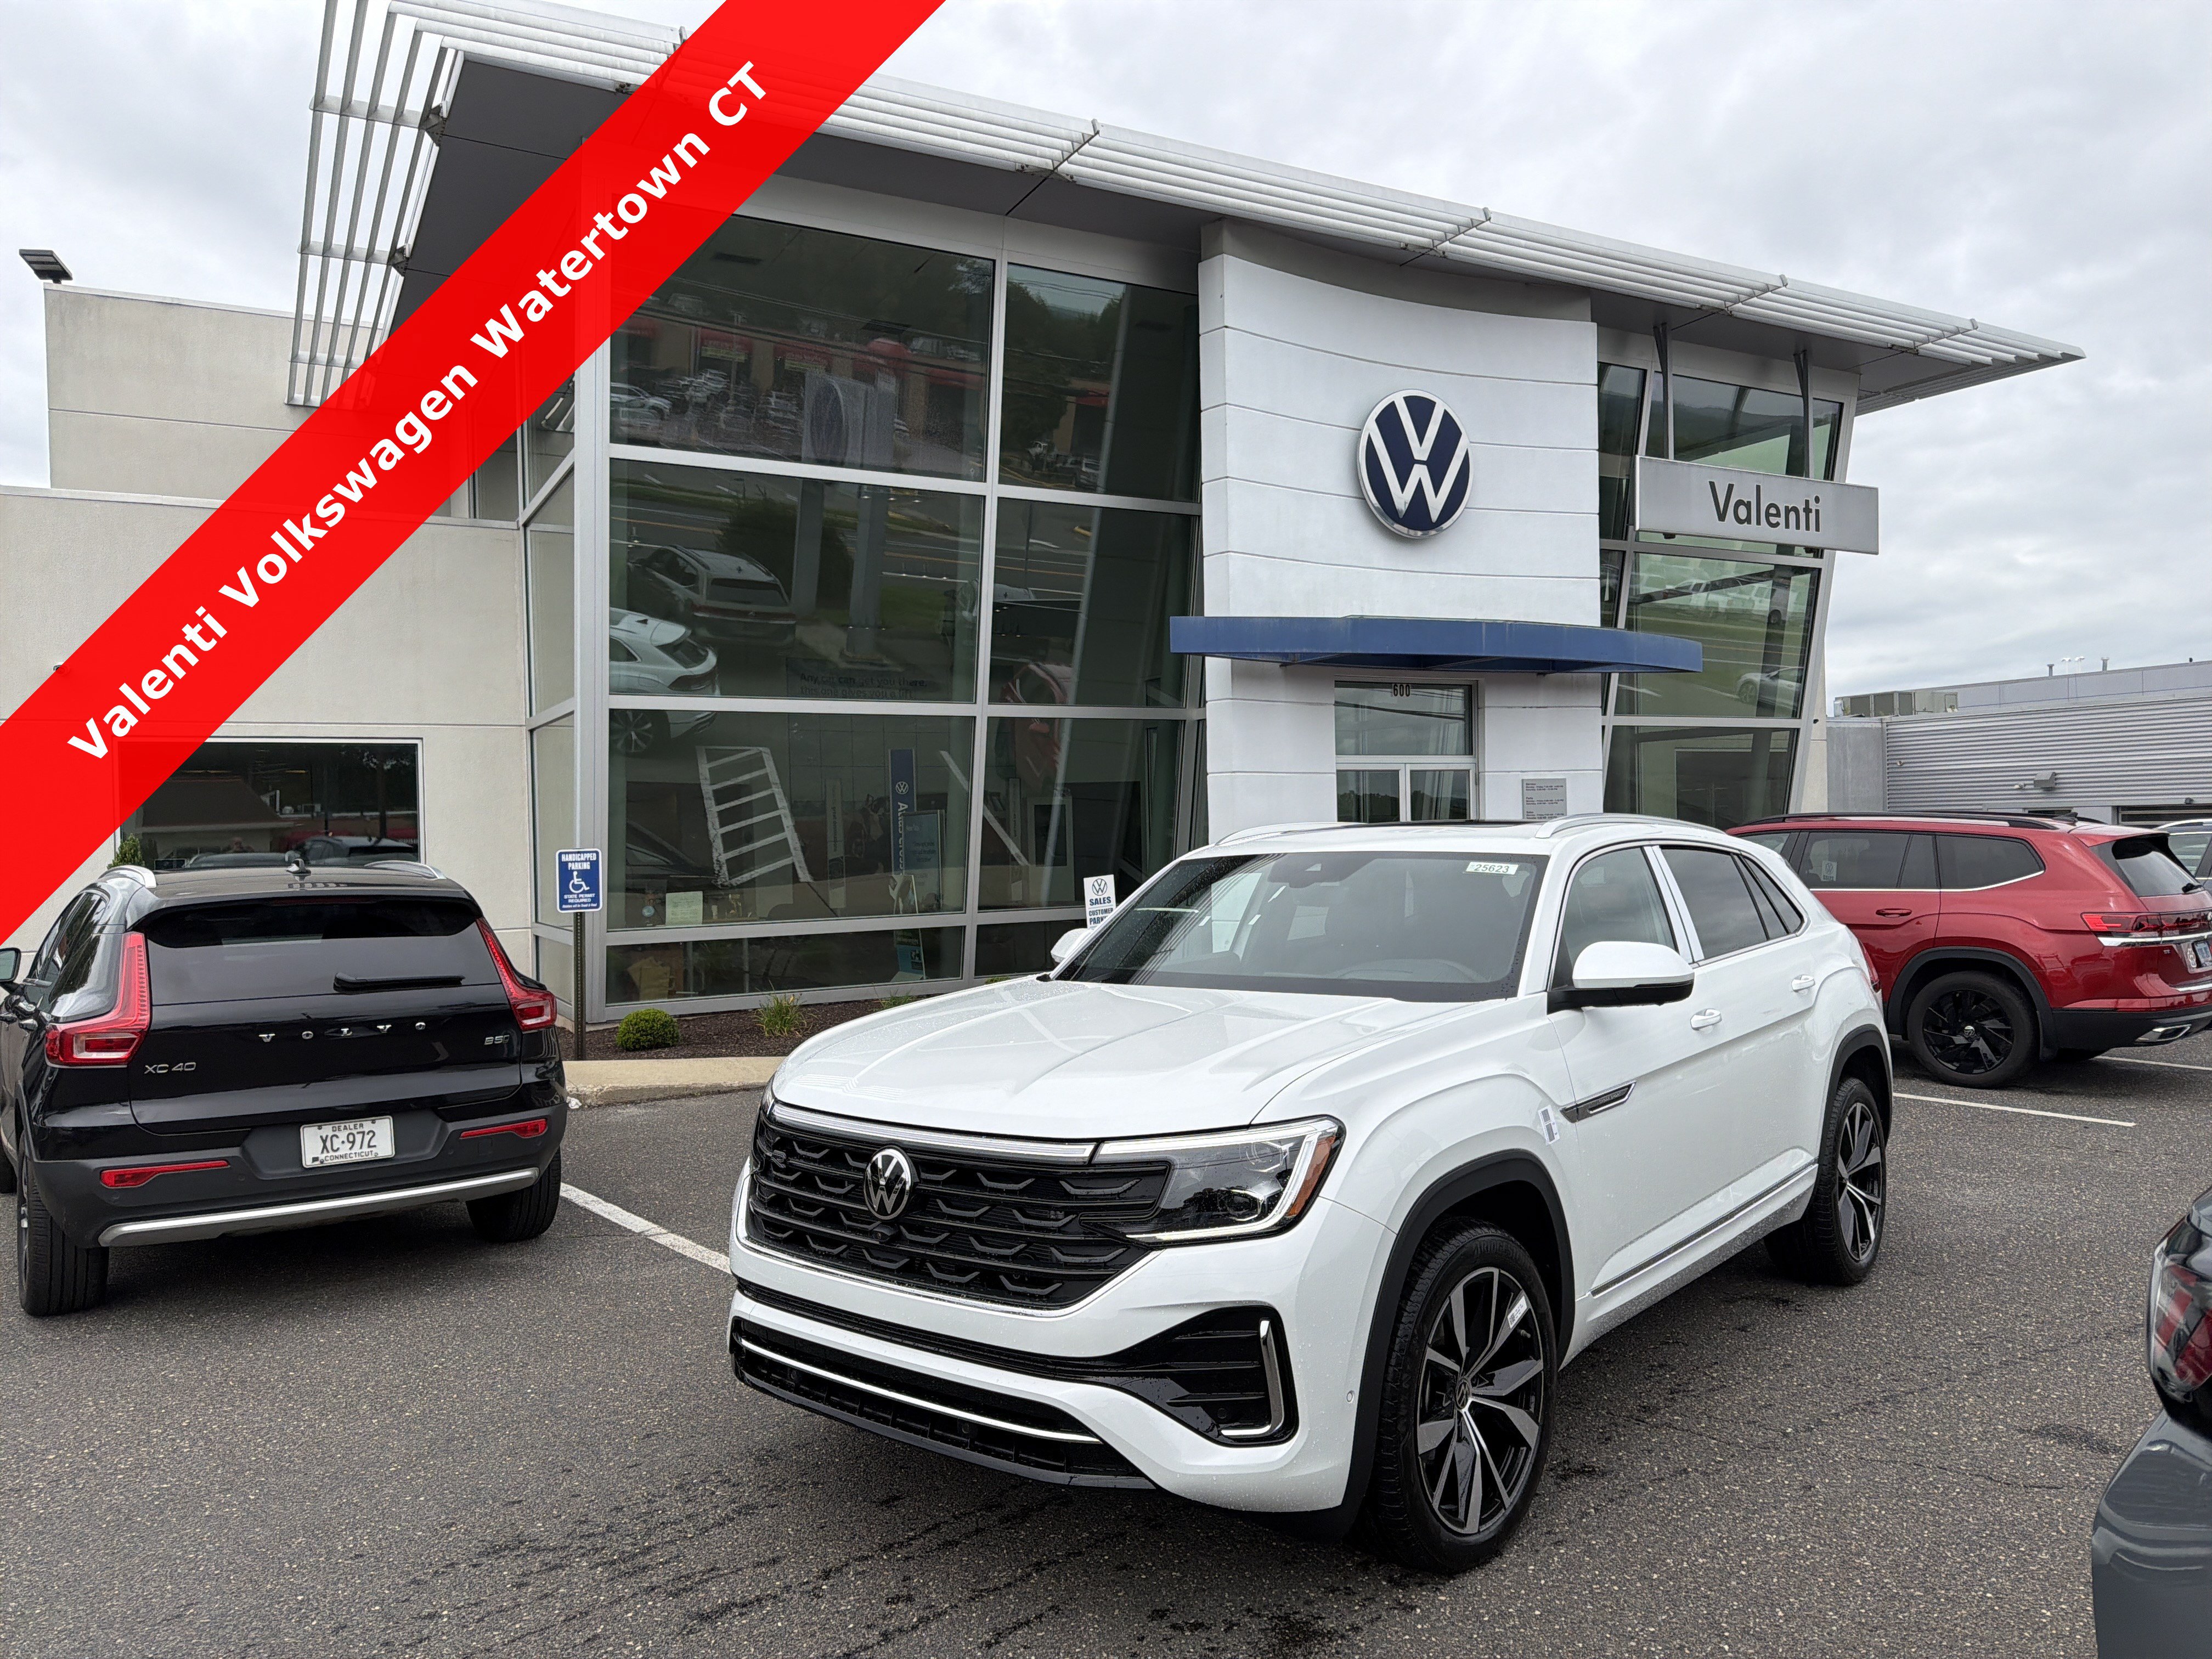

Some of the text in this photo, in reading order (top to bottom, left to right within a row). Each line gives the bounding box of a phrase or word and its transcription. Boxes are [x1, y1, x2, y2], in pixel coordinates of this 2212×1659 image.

[1708, 481, 1821, 532] Valenti
[838, 676, 855, 684] can
[877, 678, 895, 688] you
[1392, 684, 1410, 697] 600
[562, 853, 596, 862] HANDICAPPED
[568, 862, 590, 870] PARKING
[1474, 864, 1509, 873] 25623
[1090, 896, 1111, 906] SALES
[1089, 908, 1114, 916] CUSTOMER
[258, 1022, 426, 1042] VOLVO
[331, 1123, 364, 1132] DEALER
[325, 1150, 373, 1161] CONNECTICUT
